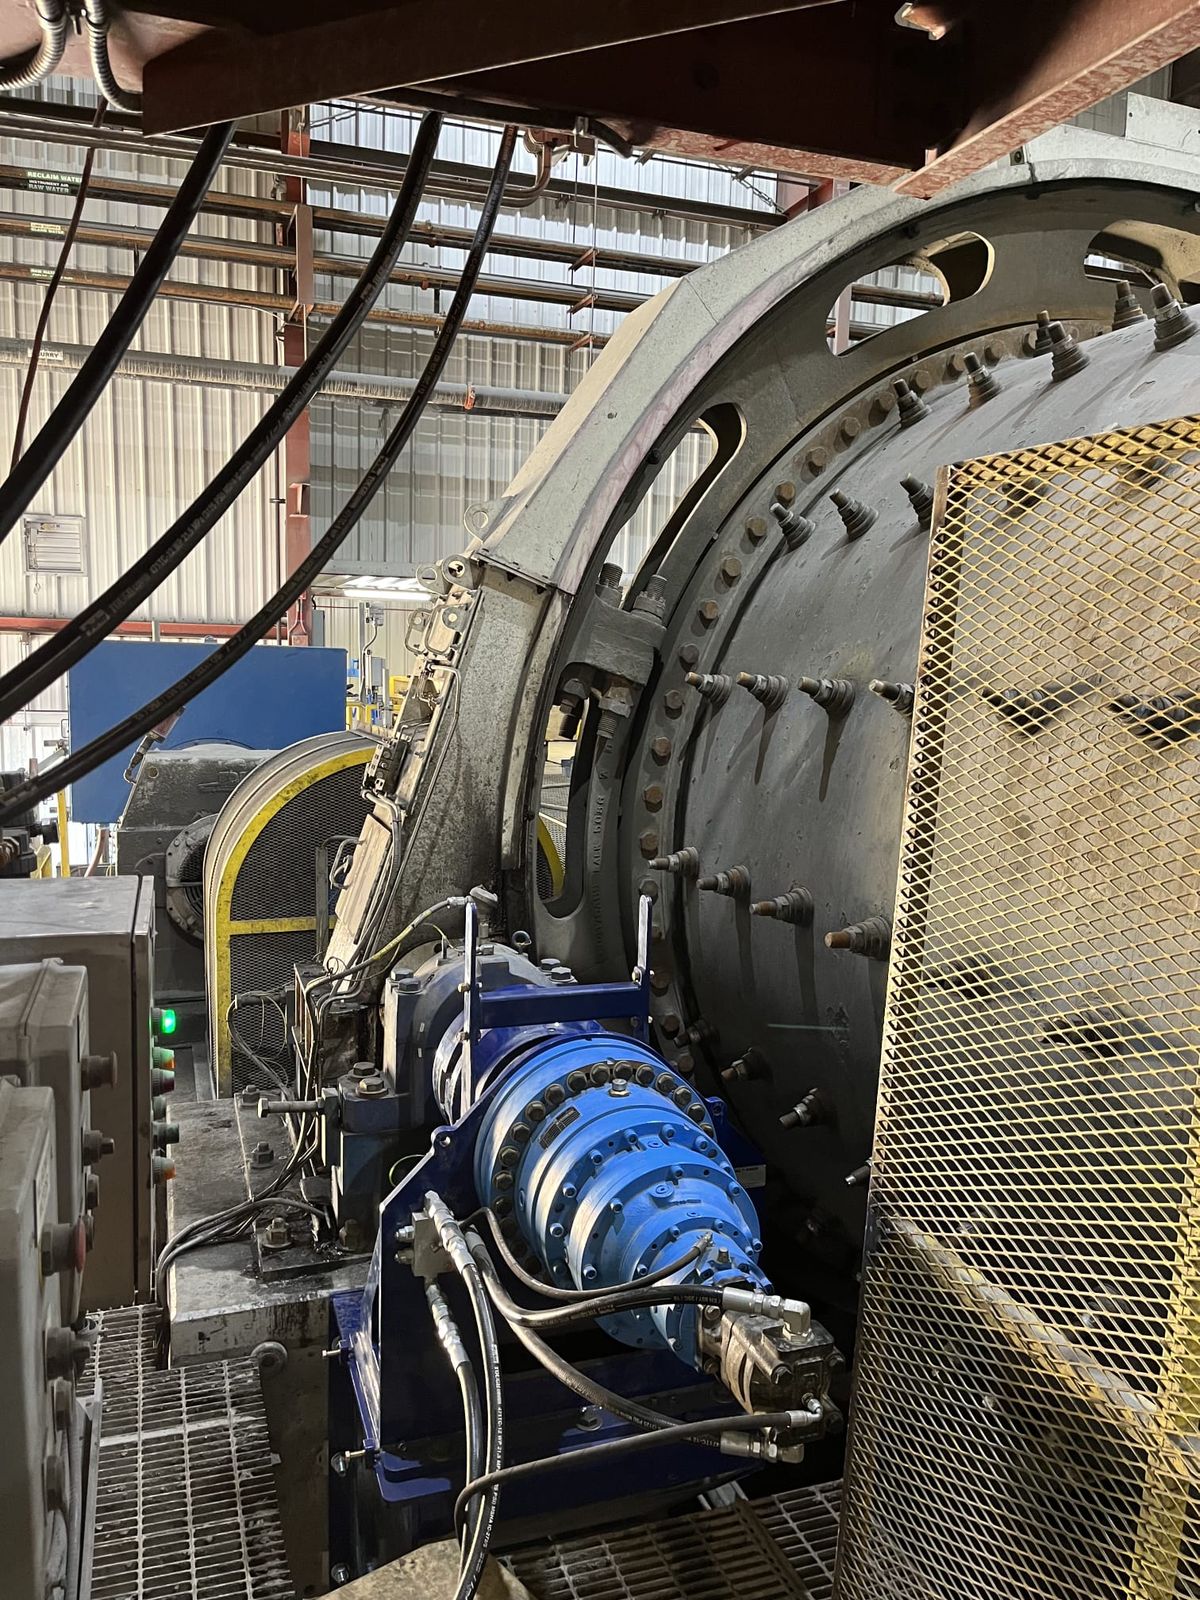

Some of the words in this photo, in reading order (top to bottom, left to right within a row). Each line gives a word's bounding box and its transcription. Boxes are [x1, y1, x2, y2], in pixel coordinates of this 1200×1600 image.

[27, 171, 60, 180] RECLAIM
[28, 183, 44, 191] RAW
[45, 185, 69, 193] WATER
